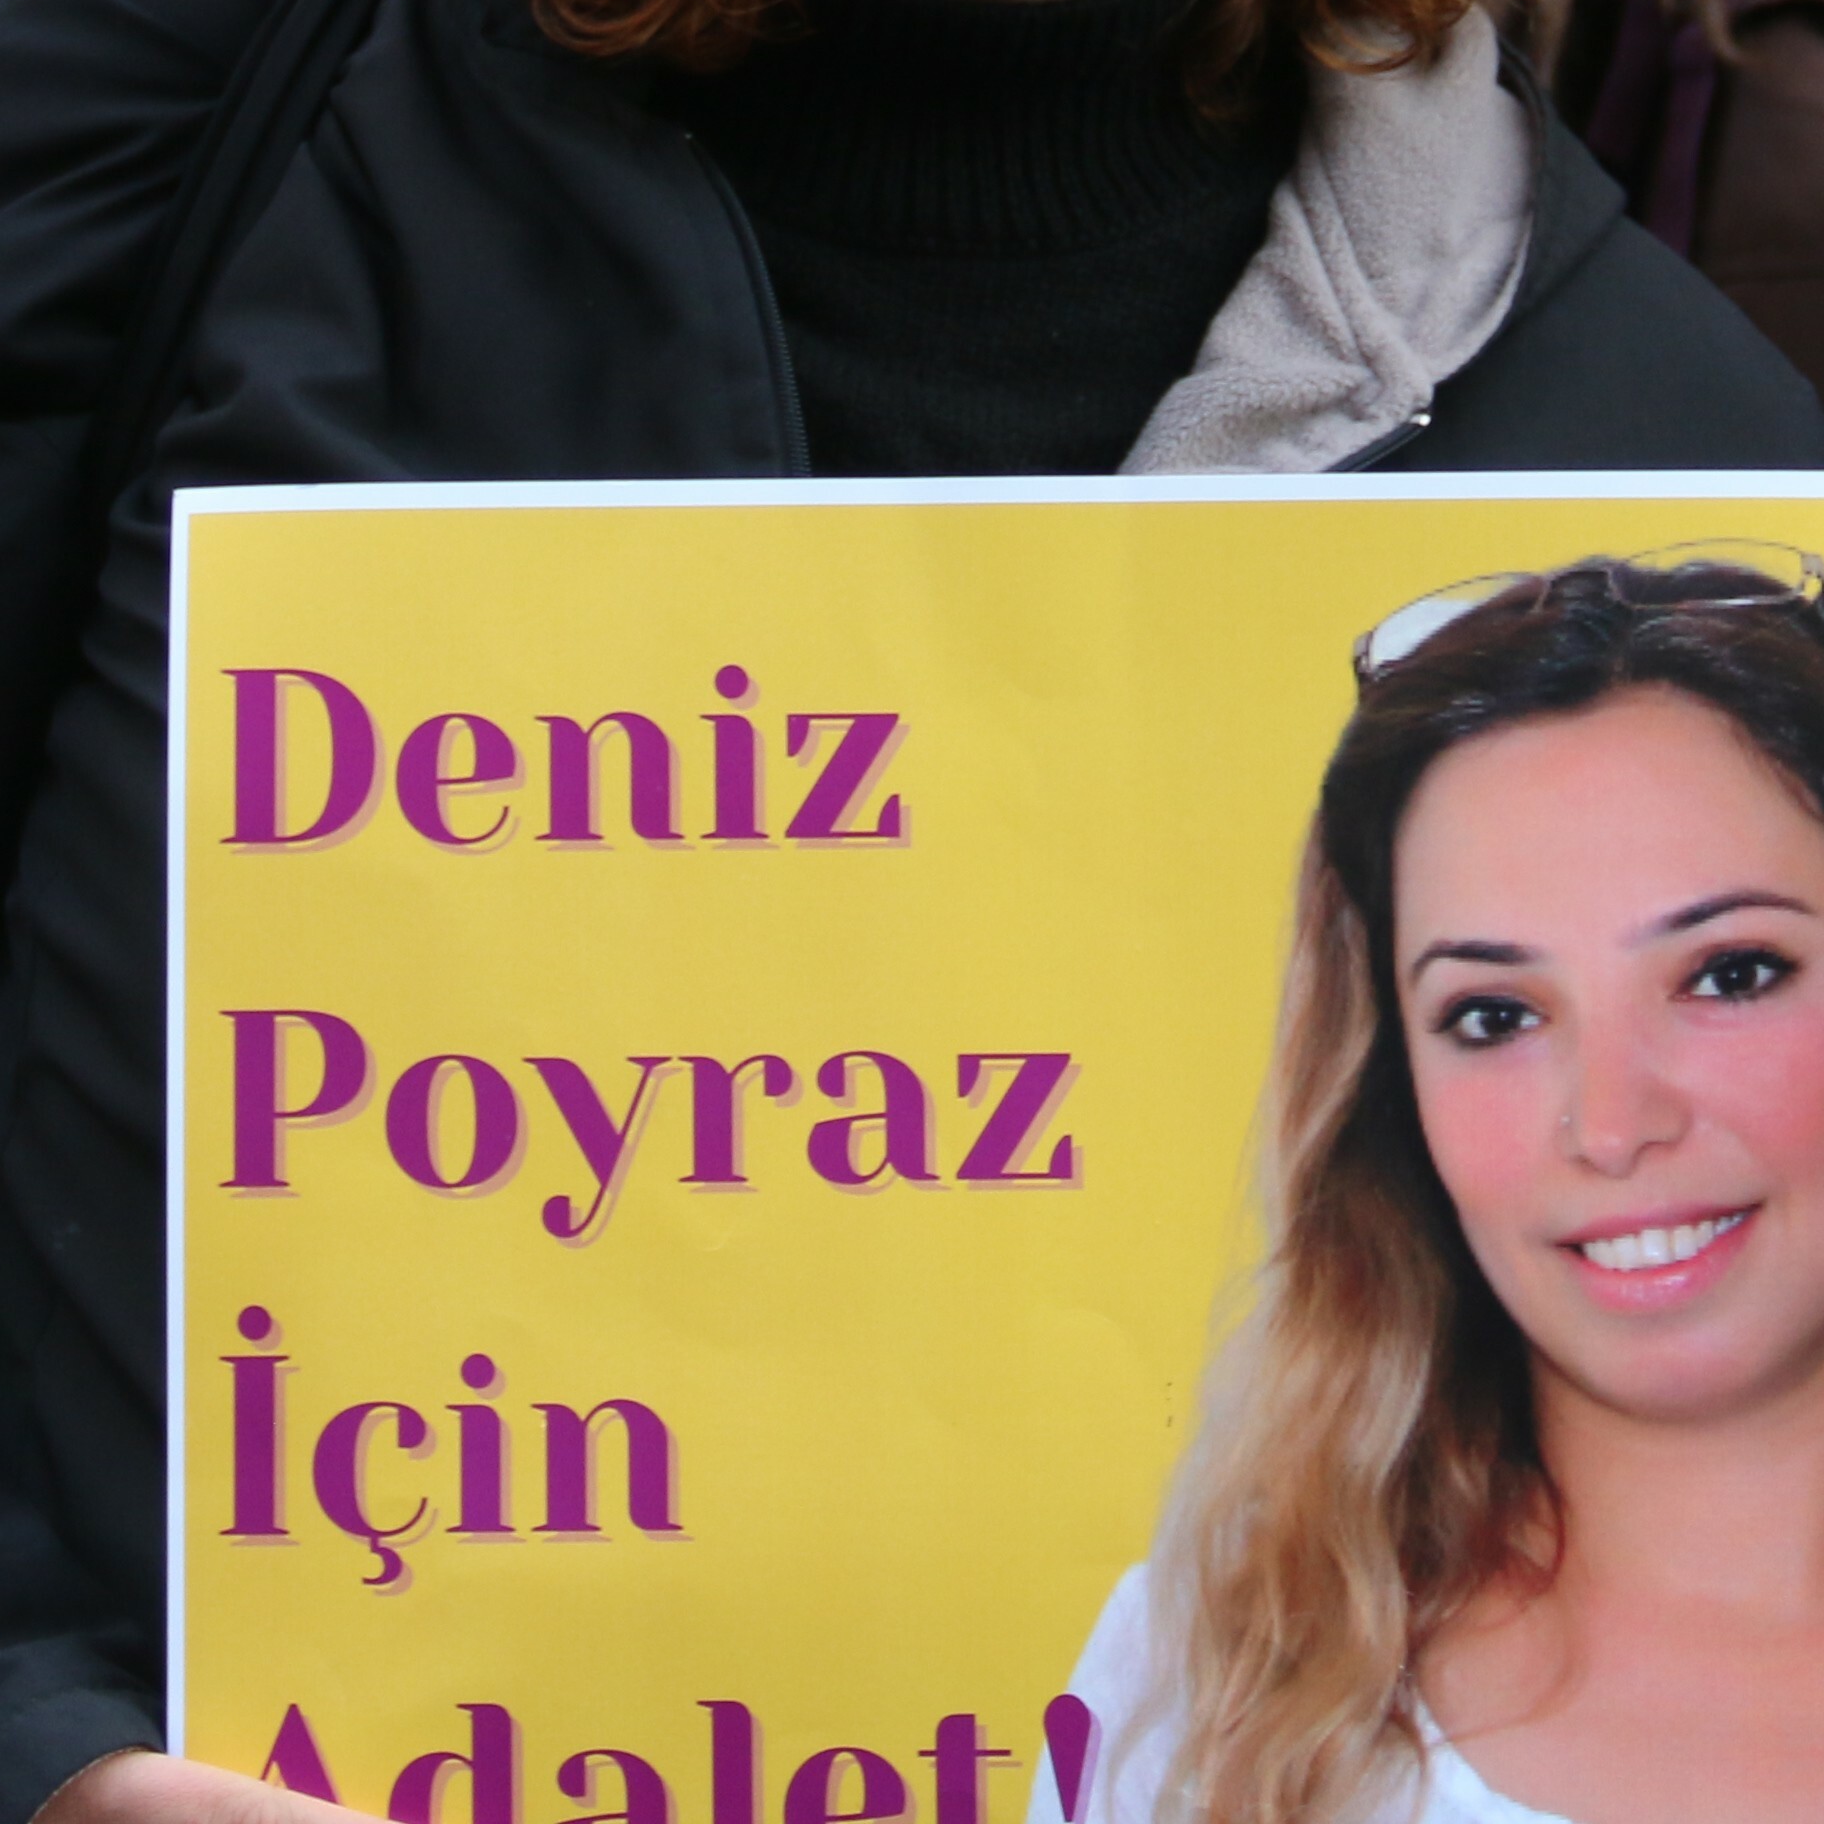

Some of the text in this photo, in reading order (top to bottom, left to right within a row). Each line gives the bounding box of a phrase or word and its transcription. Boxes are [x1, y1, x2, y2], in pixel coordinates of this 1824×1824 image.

[219, 664, 910, 855] Deniz
[219, 1007, 1083, 1249] Poyraz
[218, 1304, 693, 1595] İçin
